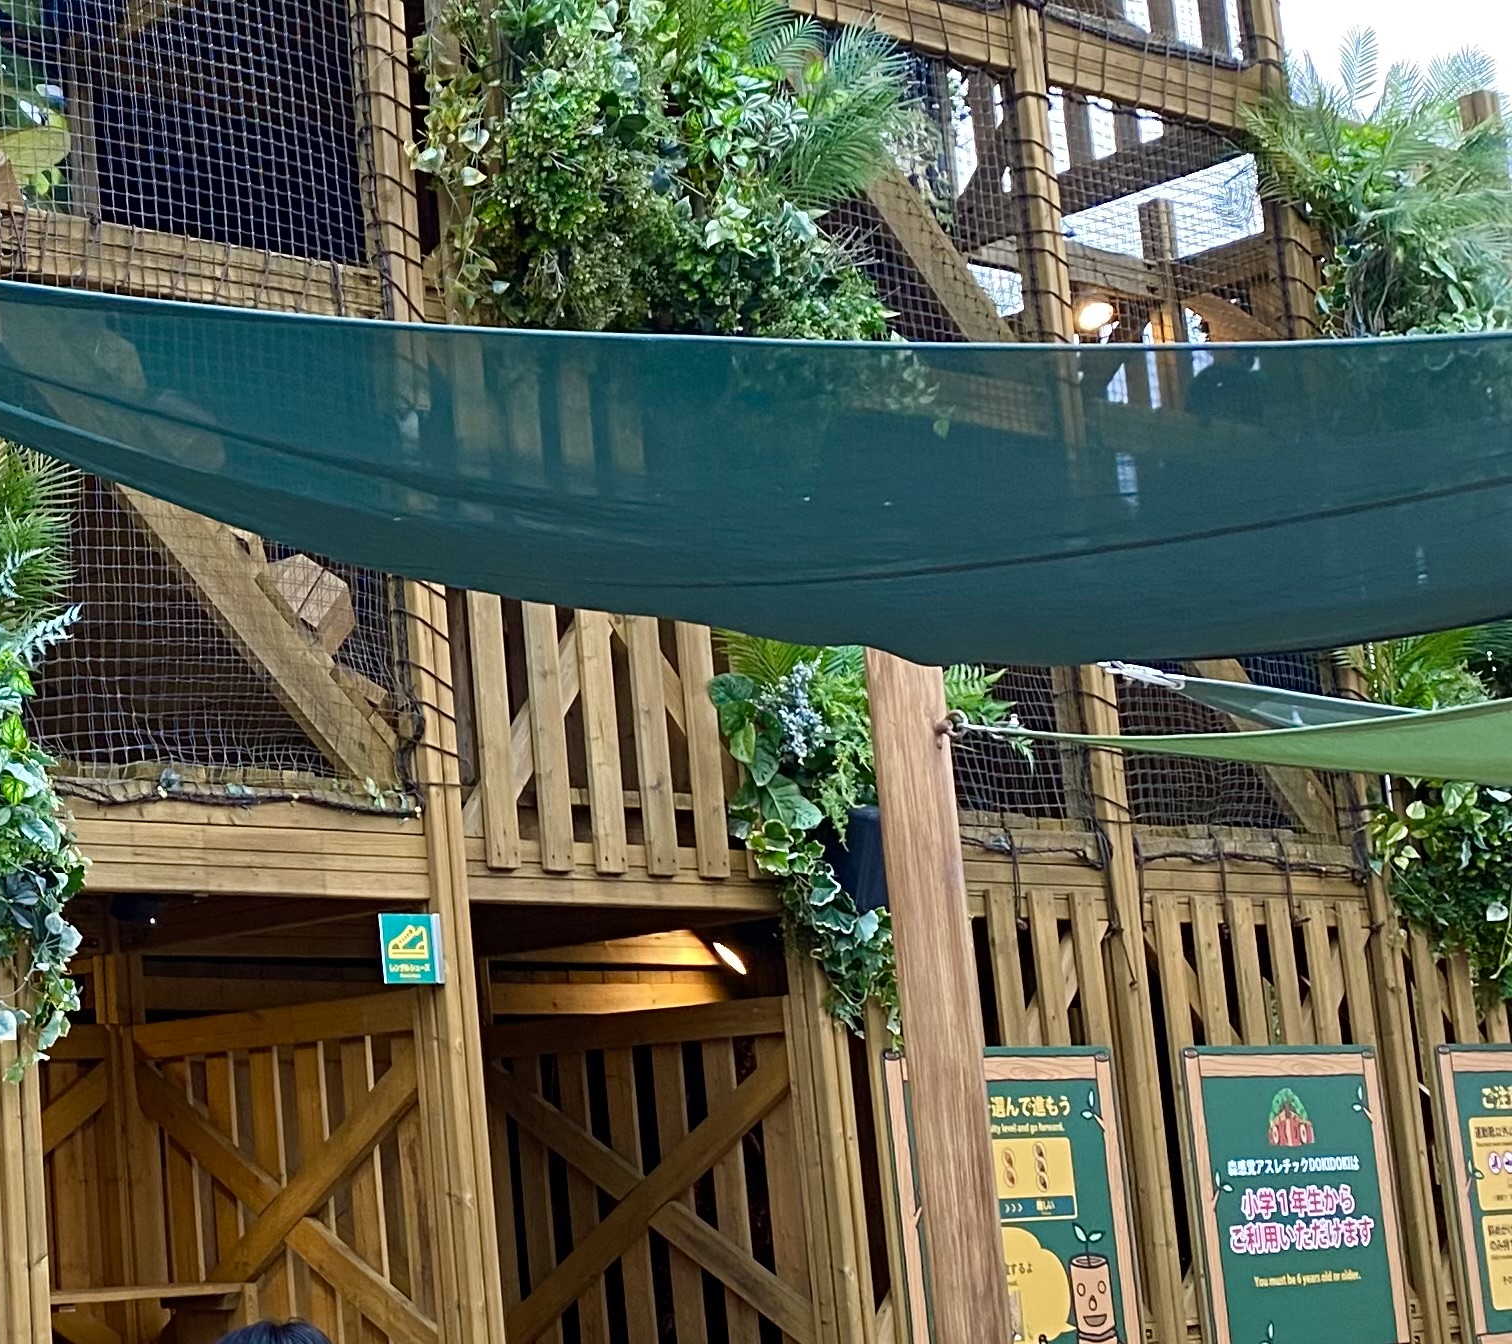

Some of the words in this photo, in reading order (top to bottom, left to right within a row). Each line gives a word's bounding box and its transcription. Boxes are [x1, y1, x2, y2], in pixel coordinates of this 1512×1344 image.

[989, 1096, 1071, 1118] 選んで進もう
[1228, 1155, 1360, 1176] 森感覚アスレチックDOKIDOKIは
[1241, 1184, 1355, 1220] 小学1年生から
[1230, 1215, 1374, 1255] ご利用いただけます
[1254, 1276, 1268, 1287] You
[1268, 1275, 1286, 1285] must
[1286, 1273, 1296, 1285] be
[1302, 1274, 1320, 1285] years
[1320, 1270, 1332, 1282] old
[1332, 1272, 1340, 1281] or
[1340, 1269, 1361, 1280] older.
